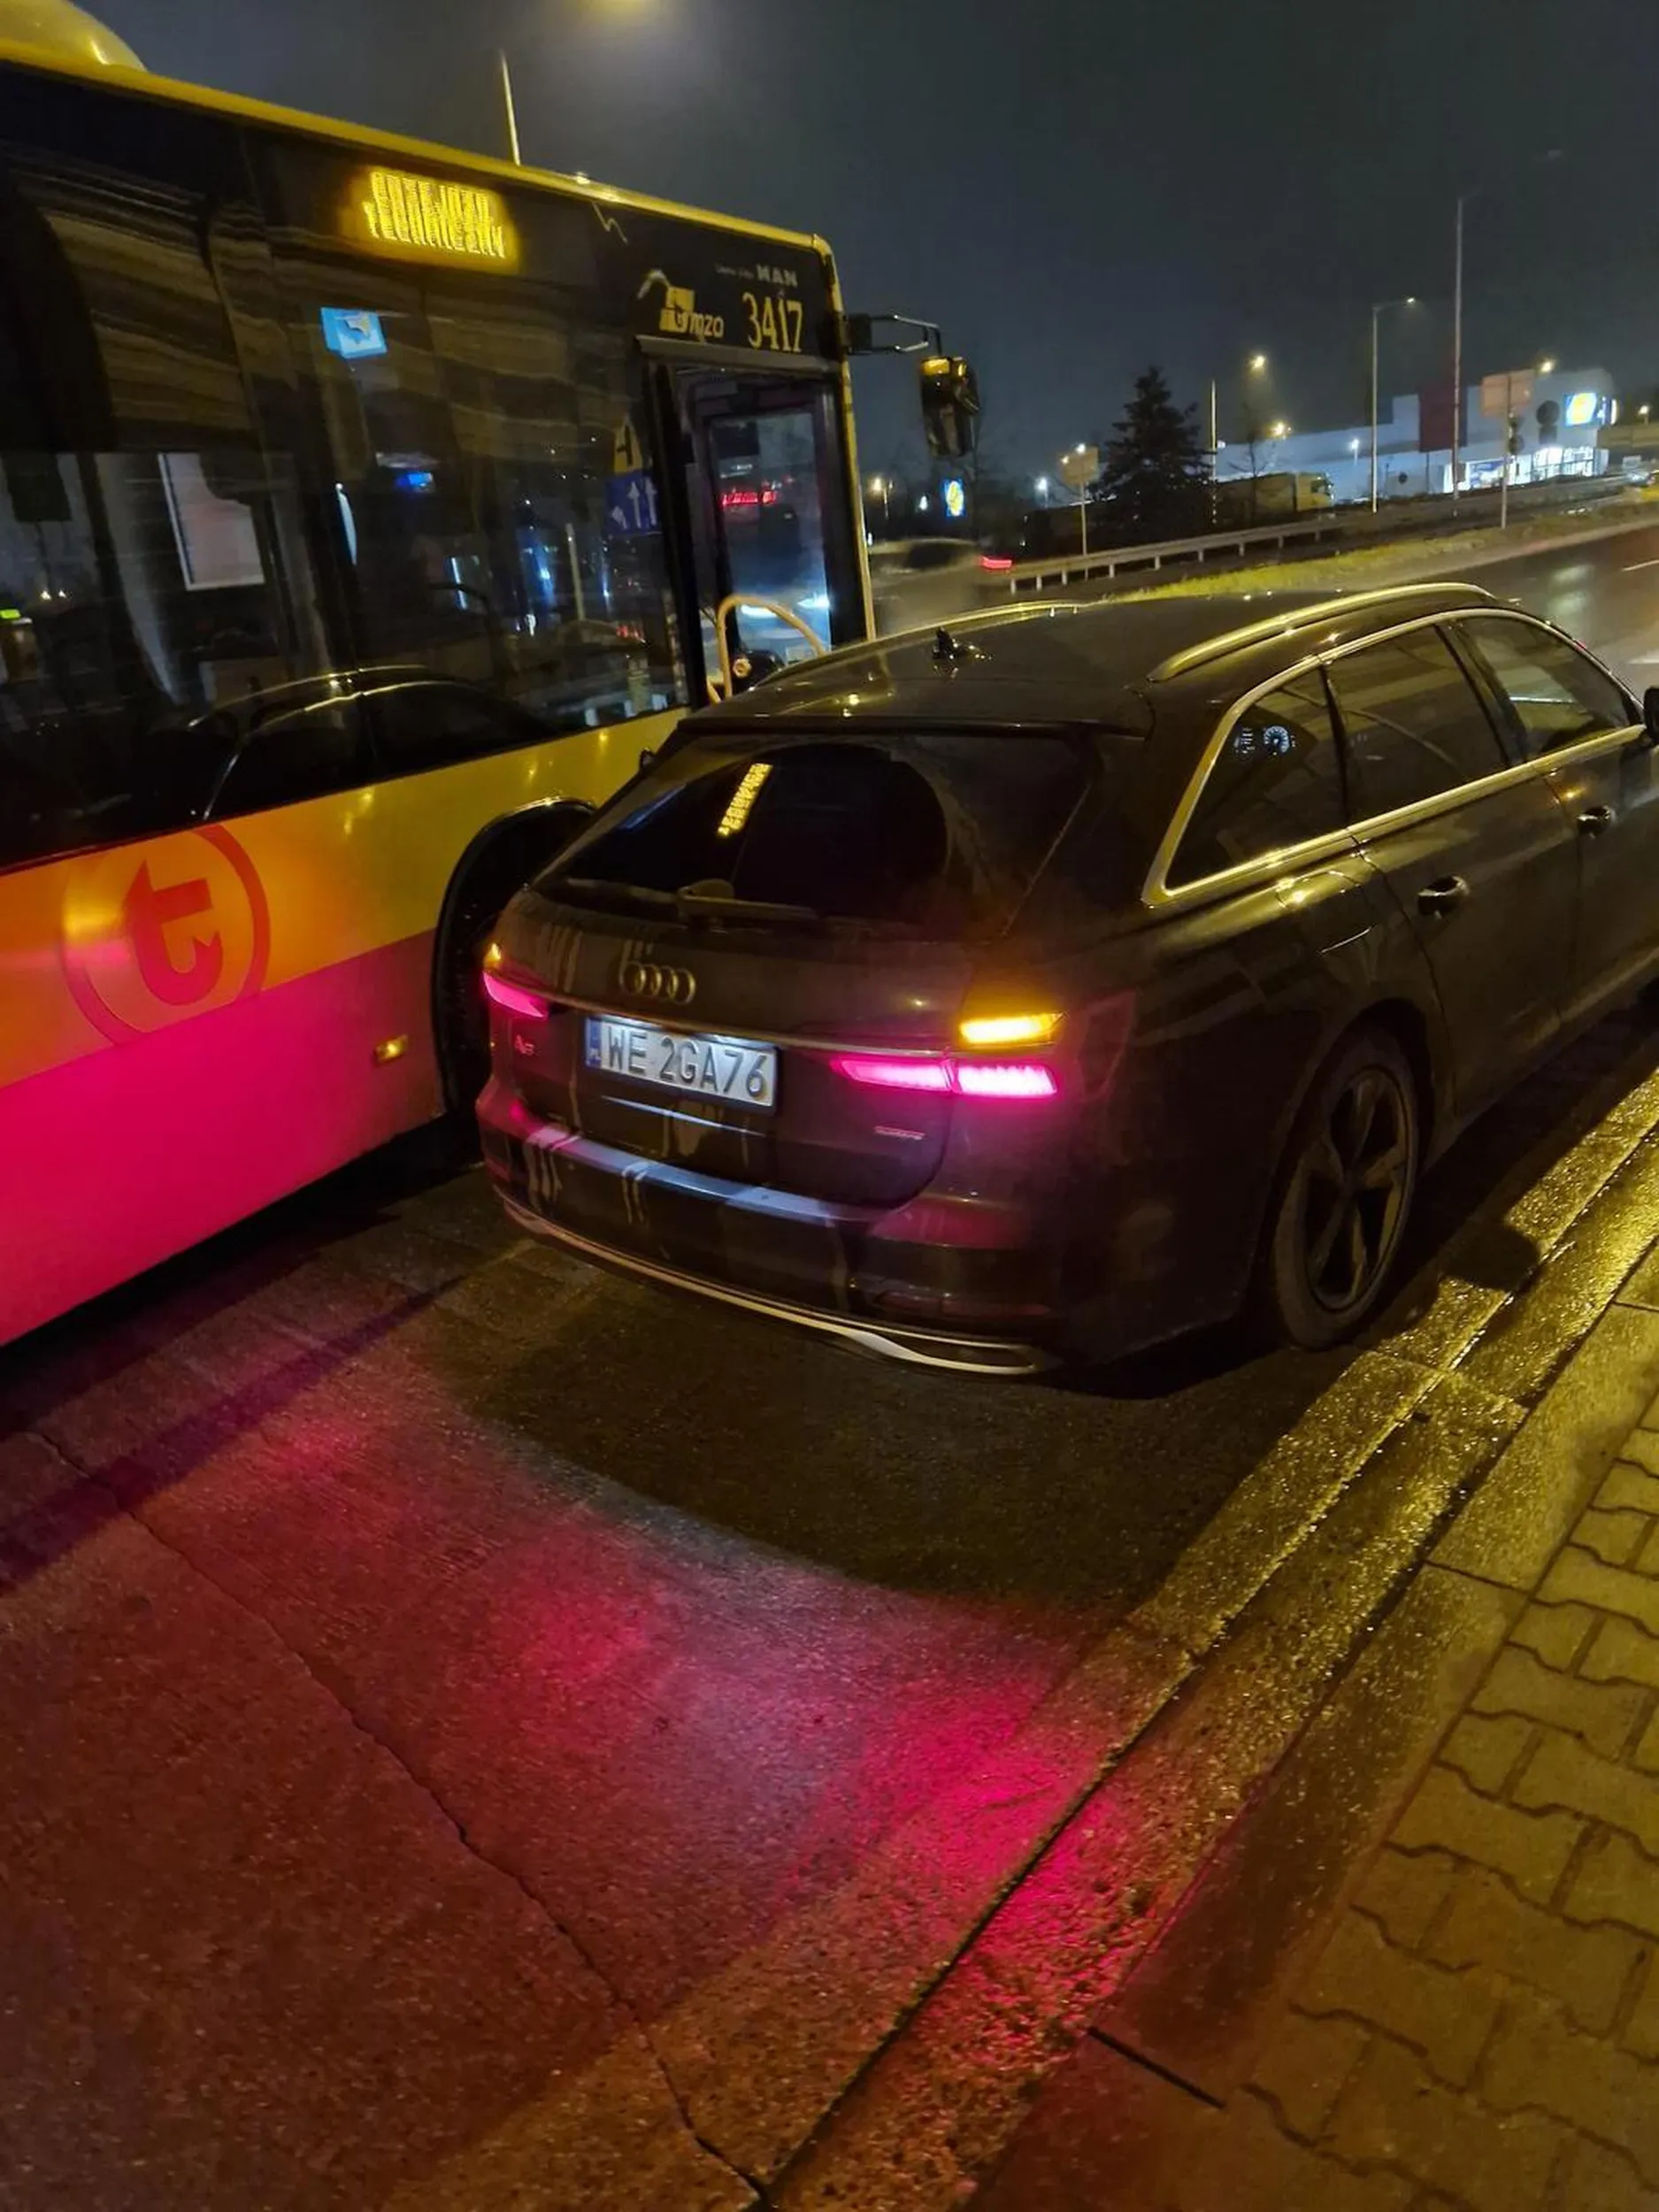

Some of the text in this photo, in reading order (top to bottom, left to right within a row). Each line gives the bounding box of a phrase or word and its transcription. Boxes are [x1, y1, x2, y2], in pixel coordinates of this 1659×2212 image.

[757, 265, 797, 287] MAN
[741, 291, 803, 353] 3417
[608, 1025, 768, 1099] WE 2GA76
